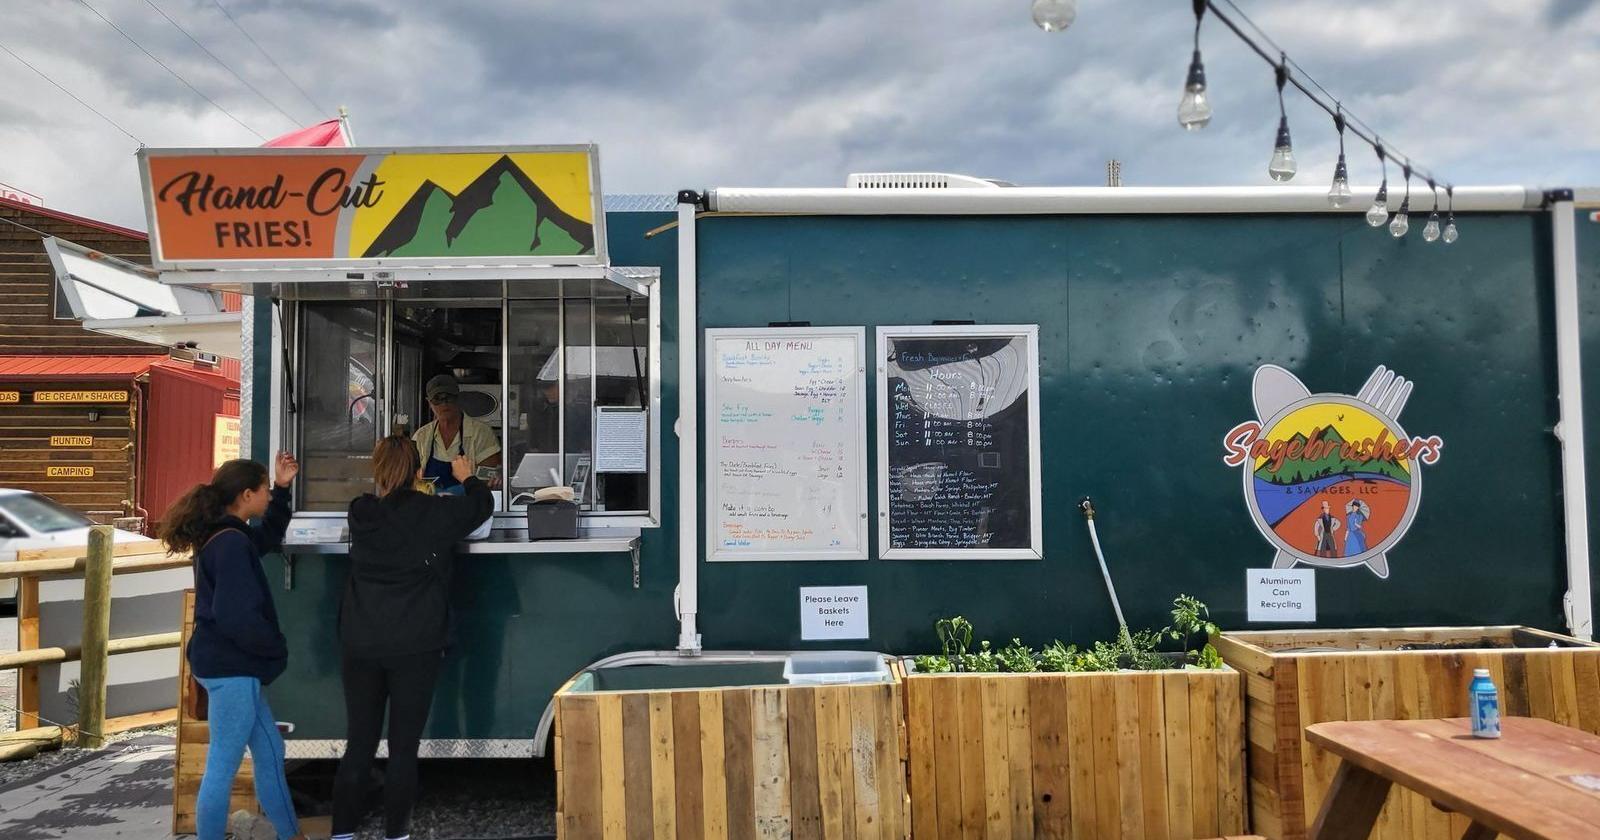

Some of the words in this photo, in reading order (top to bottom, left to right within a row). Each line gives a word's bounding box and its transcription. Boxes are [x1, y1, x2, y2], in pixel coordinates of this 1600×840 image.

[159, 167, 385, 216] Hand-Cut
[215, 220, 312, 248] FRIES!
[745, 341, 760, 351] ALL
[765, 341, 781, 351] DAY
[786, 341, 813, 351] MENU
[901, 352, 925, 362] Fresh
[930, 370, 962, 379] Hours
[91, 392, 125, 400] SHAKES
[895, 421, 905, 429] Fri
[895, 430, 908, 438] Sat
[52, 437, 91, 445] HUNTING
[1224, 421, 1442, 473] Sagebrushers
[1285, 486, 1293, 495] &
[1360, 486, 1378, 495] LLC
[1260, 577, 1302, 585] Aluminum
[1272, 588, 1290, 596] Can
[806, 595, 832, 603] Please
[1260, 600, 1302, 609] Recycling
[819, 607, 849, 615] Baskets
